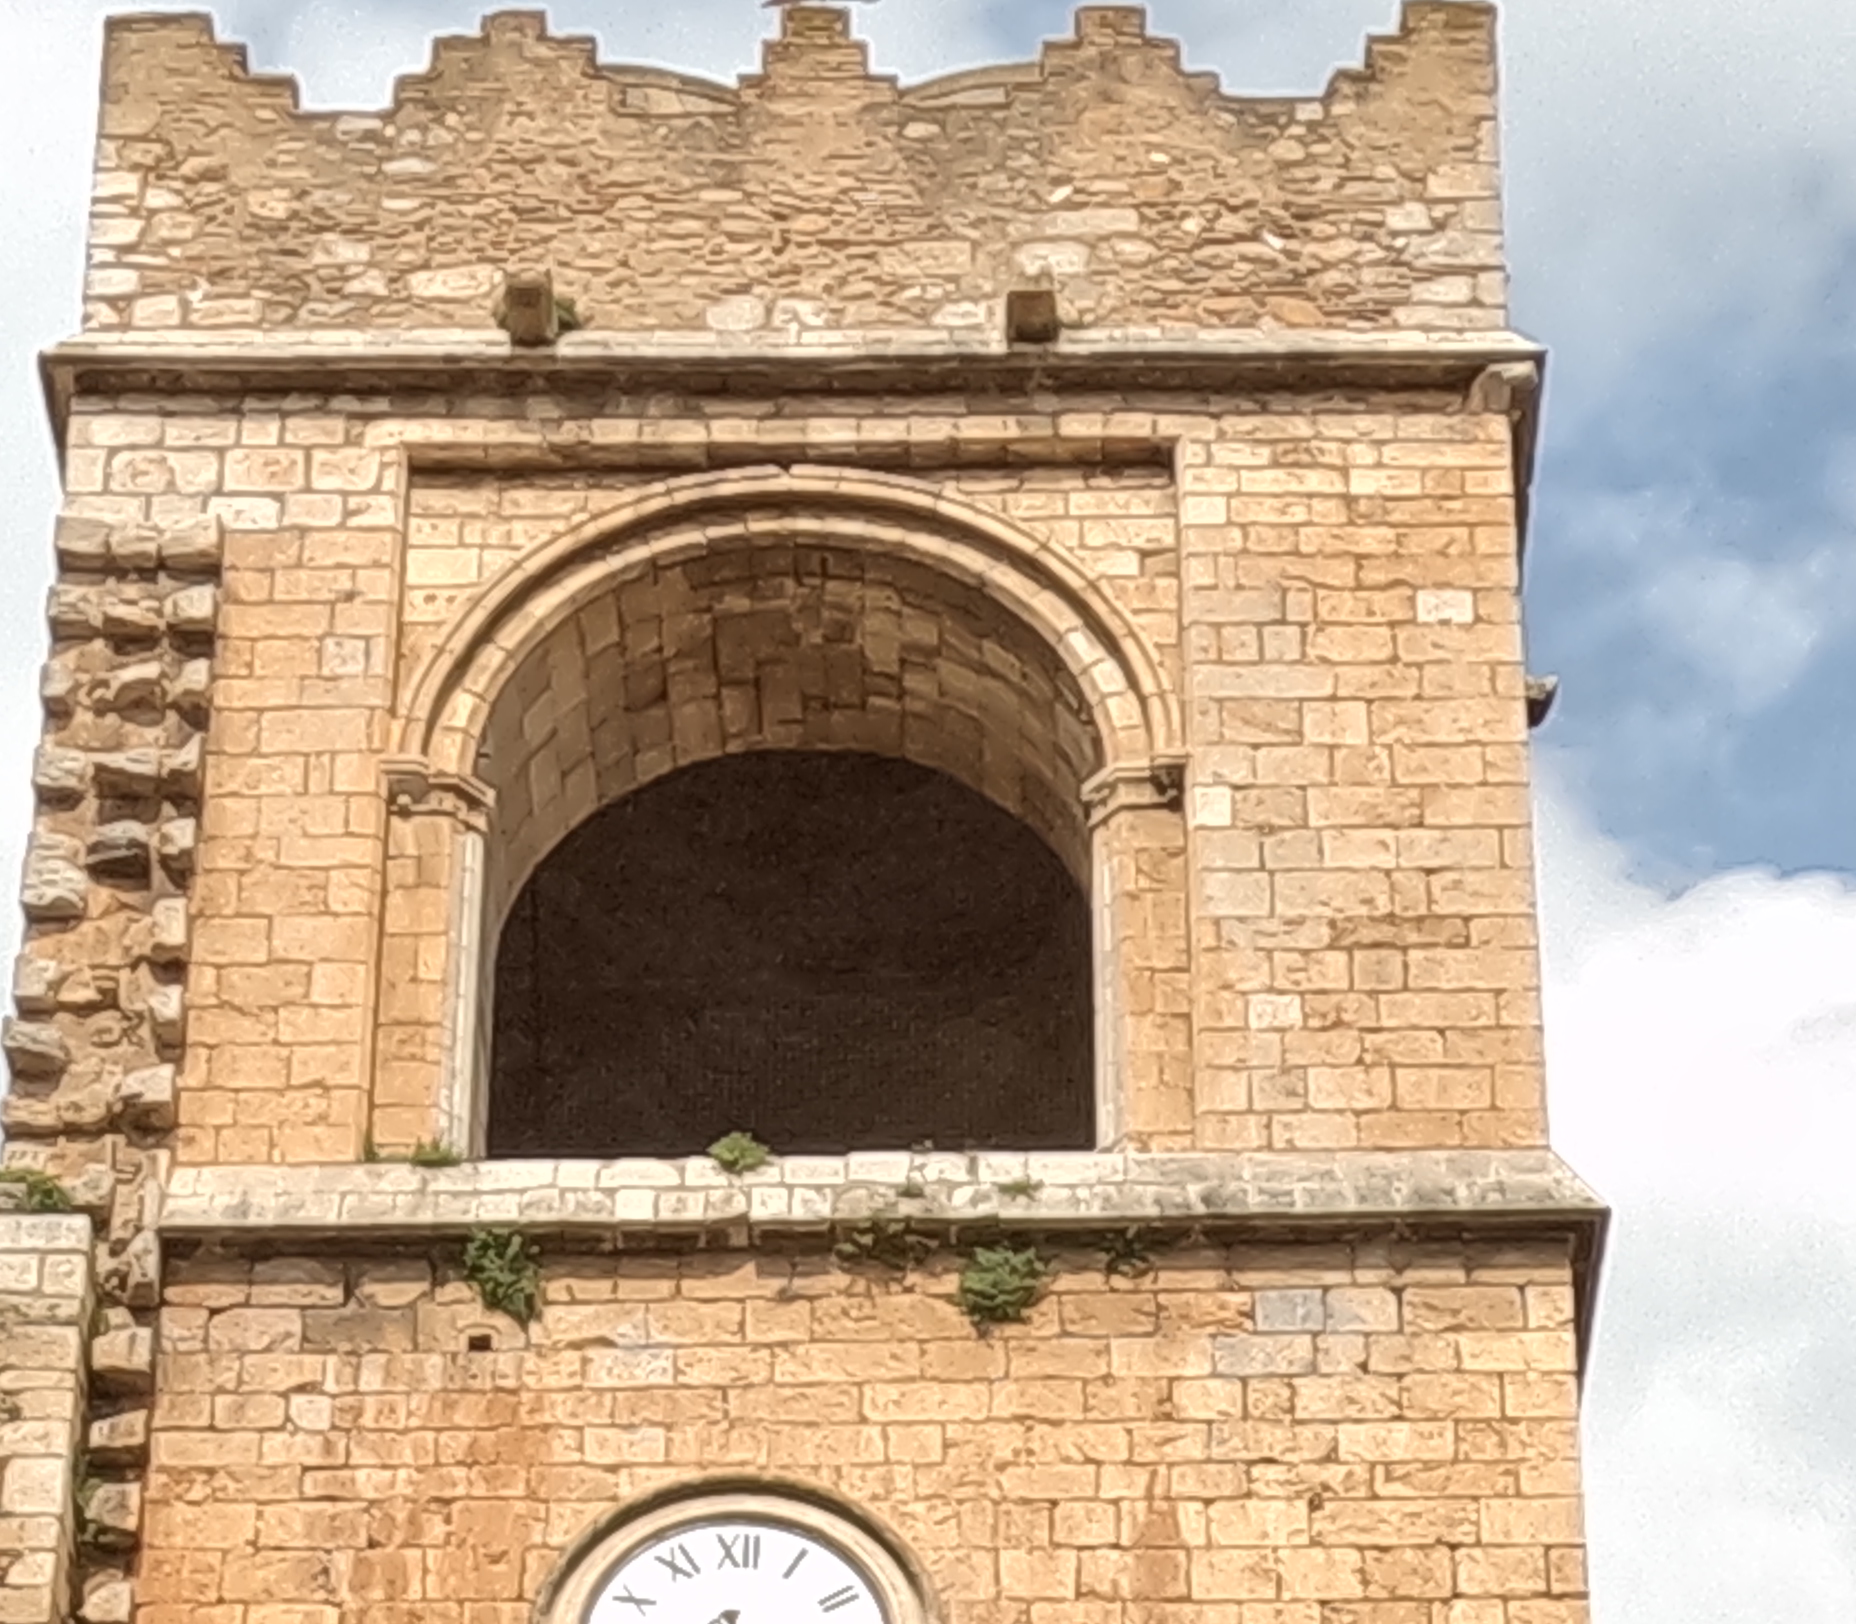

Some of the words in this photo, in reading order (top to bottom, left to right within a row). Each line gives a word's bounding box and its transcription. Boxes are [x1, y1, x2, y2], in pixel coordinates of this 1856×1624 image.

[654, 1543, 700, 1582] XI
[715, 1534, 760, 1569] XII
[782, 1547, 809, 1580] I
[611, 1584, 657, 1616] X
[817, 1585, 860, 1613] II
